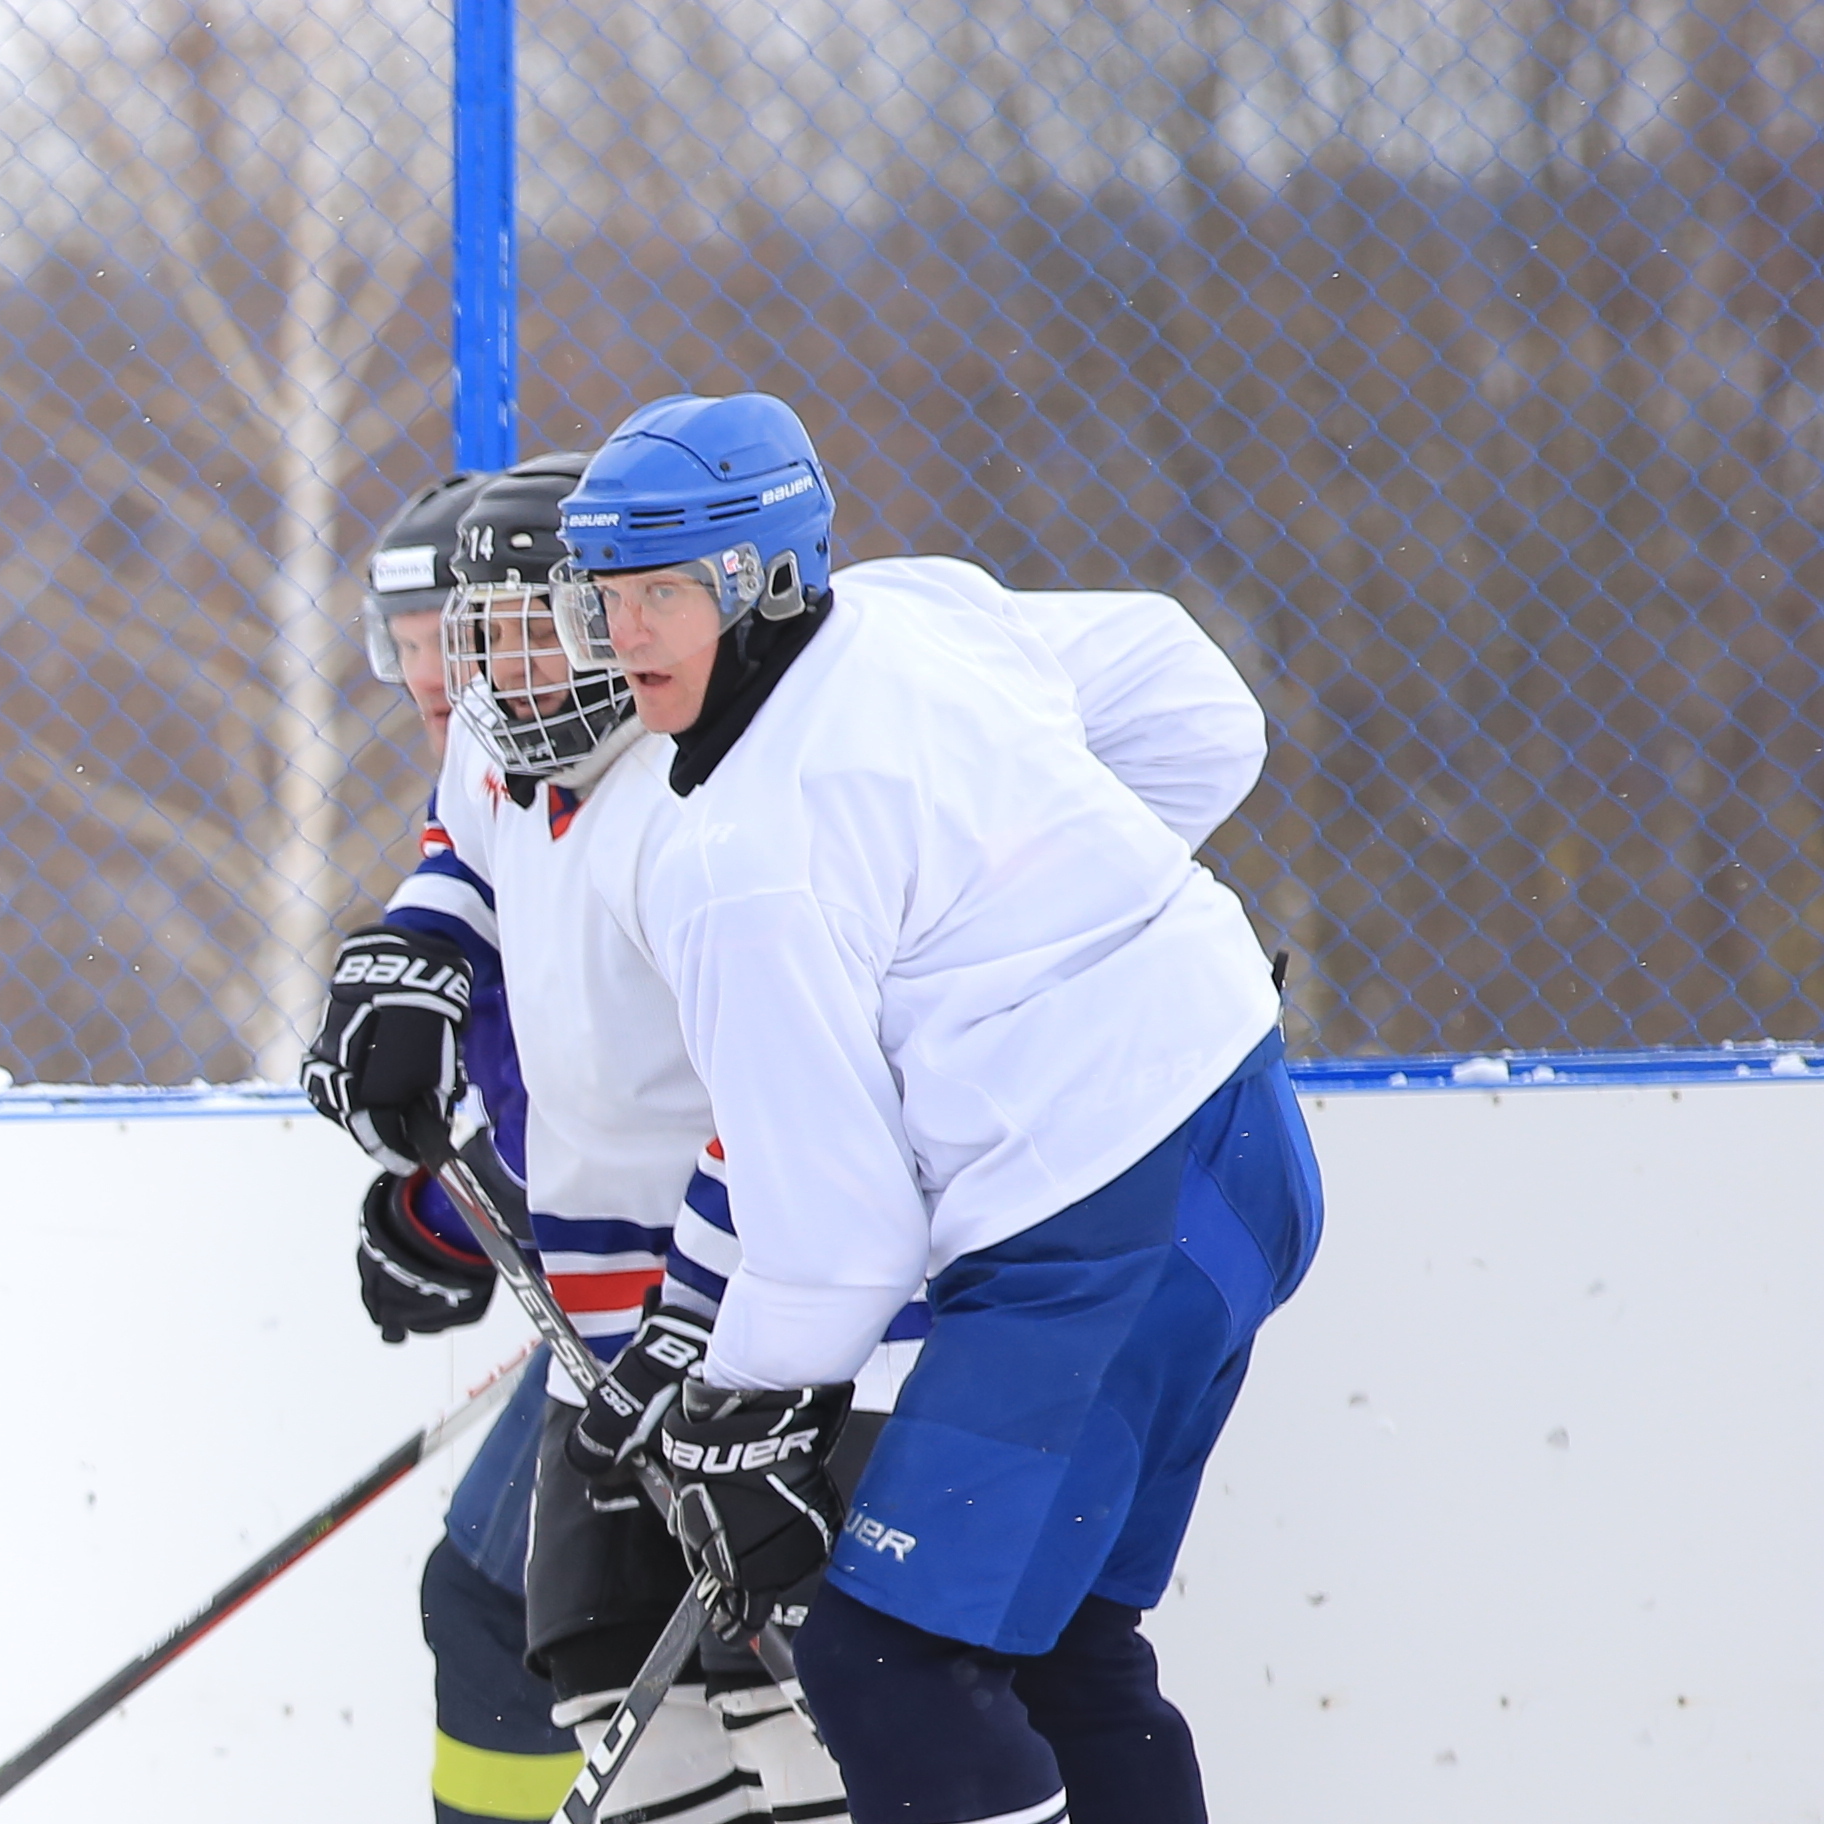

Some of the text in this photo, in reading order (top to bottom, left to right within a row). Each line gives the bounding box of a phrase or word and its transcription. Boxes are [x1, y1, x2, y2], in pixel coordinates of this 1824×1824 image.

[762, 475, 814, 506] BAUER
[568, 513, 620, 528] BAUER
[469, 526, 494, 562] 14
